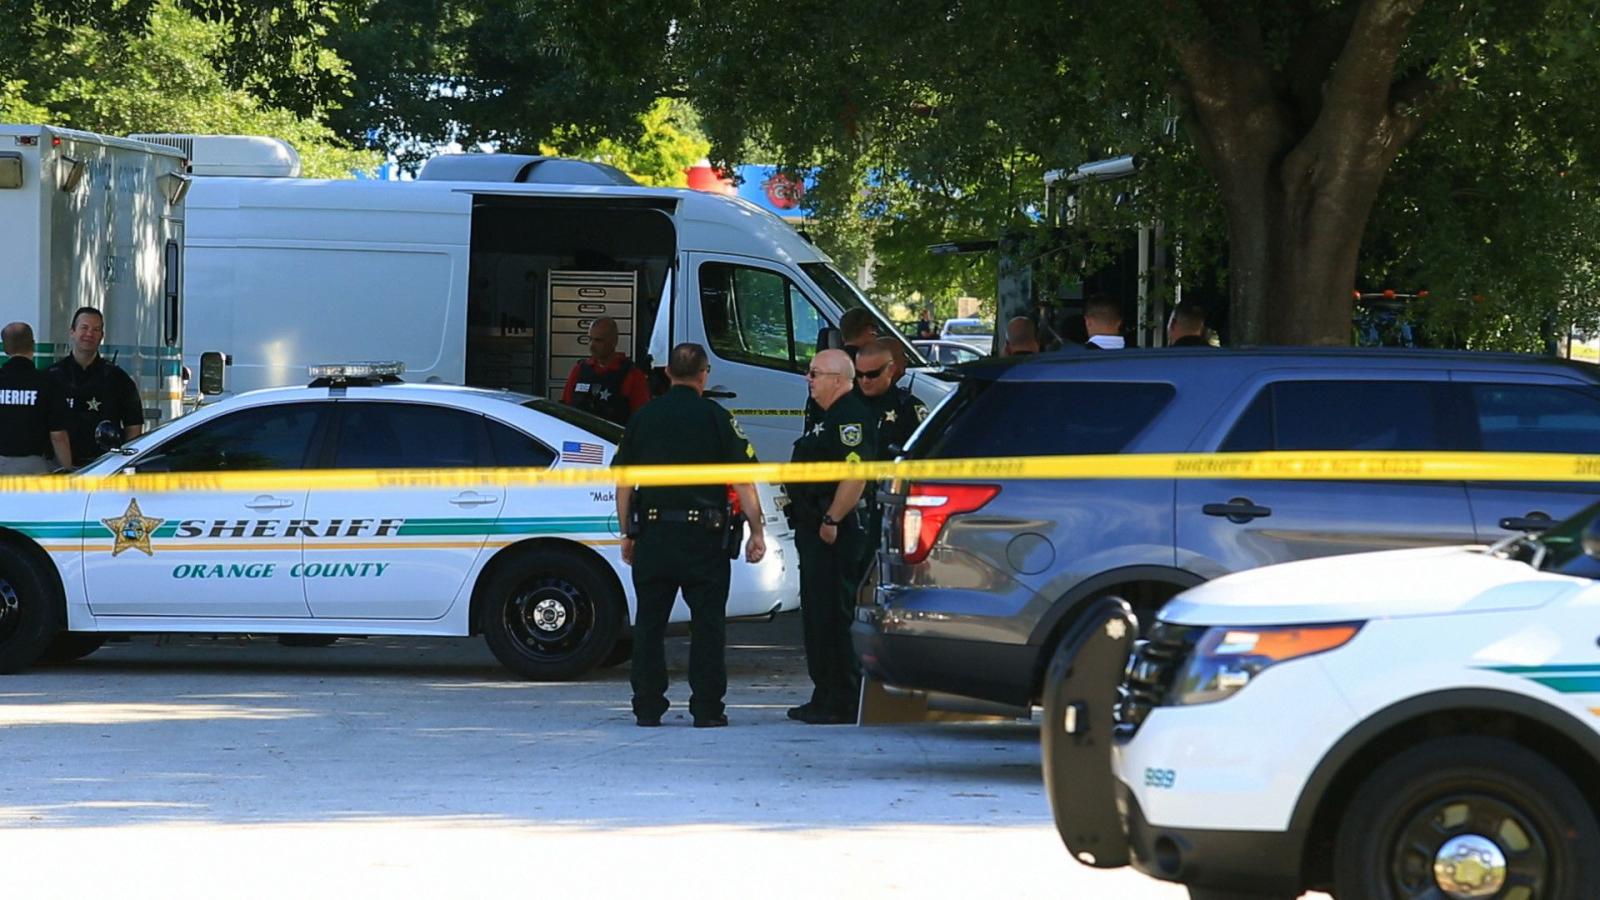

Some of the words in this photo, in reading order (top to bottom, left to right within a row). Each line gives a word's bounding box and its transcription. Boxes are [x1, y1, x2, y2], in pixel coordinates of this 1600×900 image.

[0, 389, 38, 406] HERIFF
[175, 519, 403, 537] SHERIFF
[172, 563, 276, 579] ORANGE
[290, 562, 389, 577] COUNTY
[1145, 767, 1175, 788] 999
